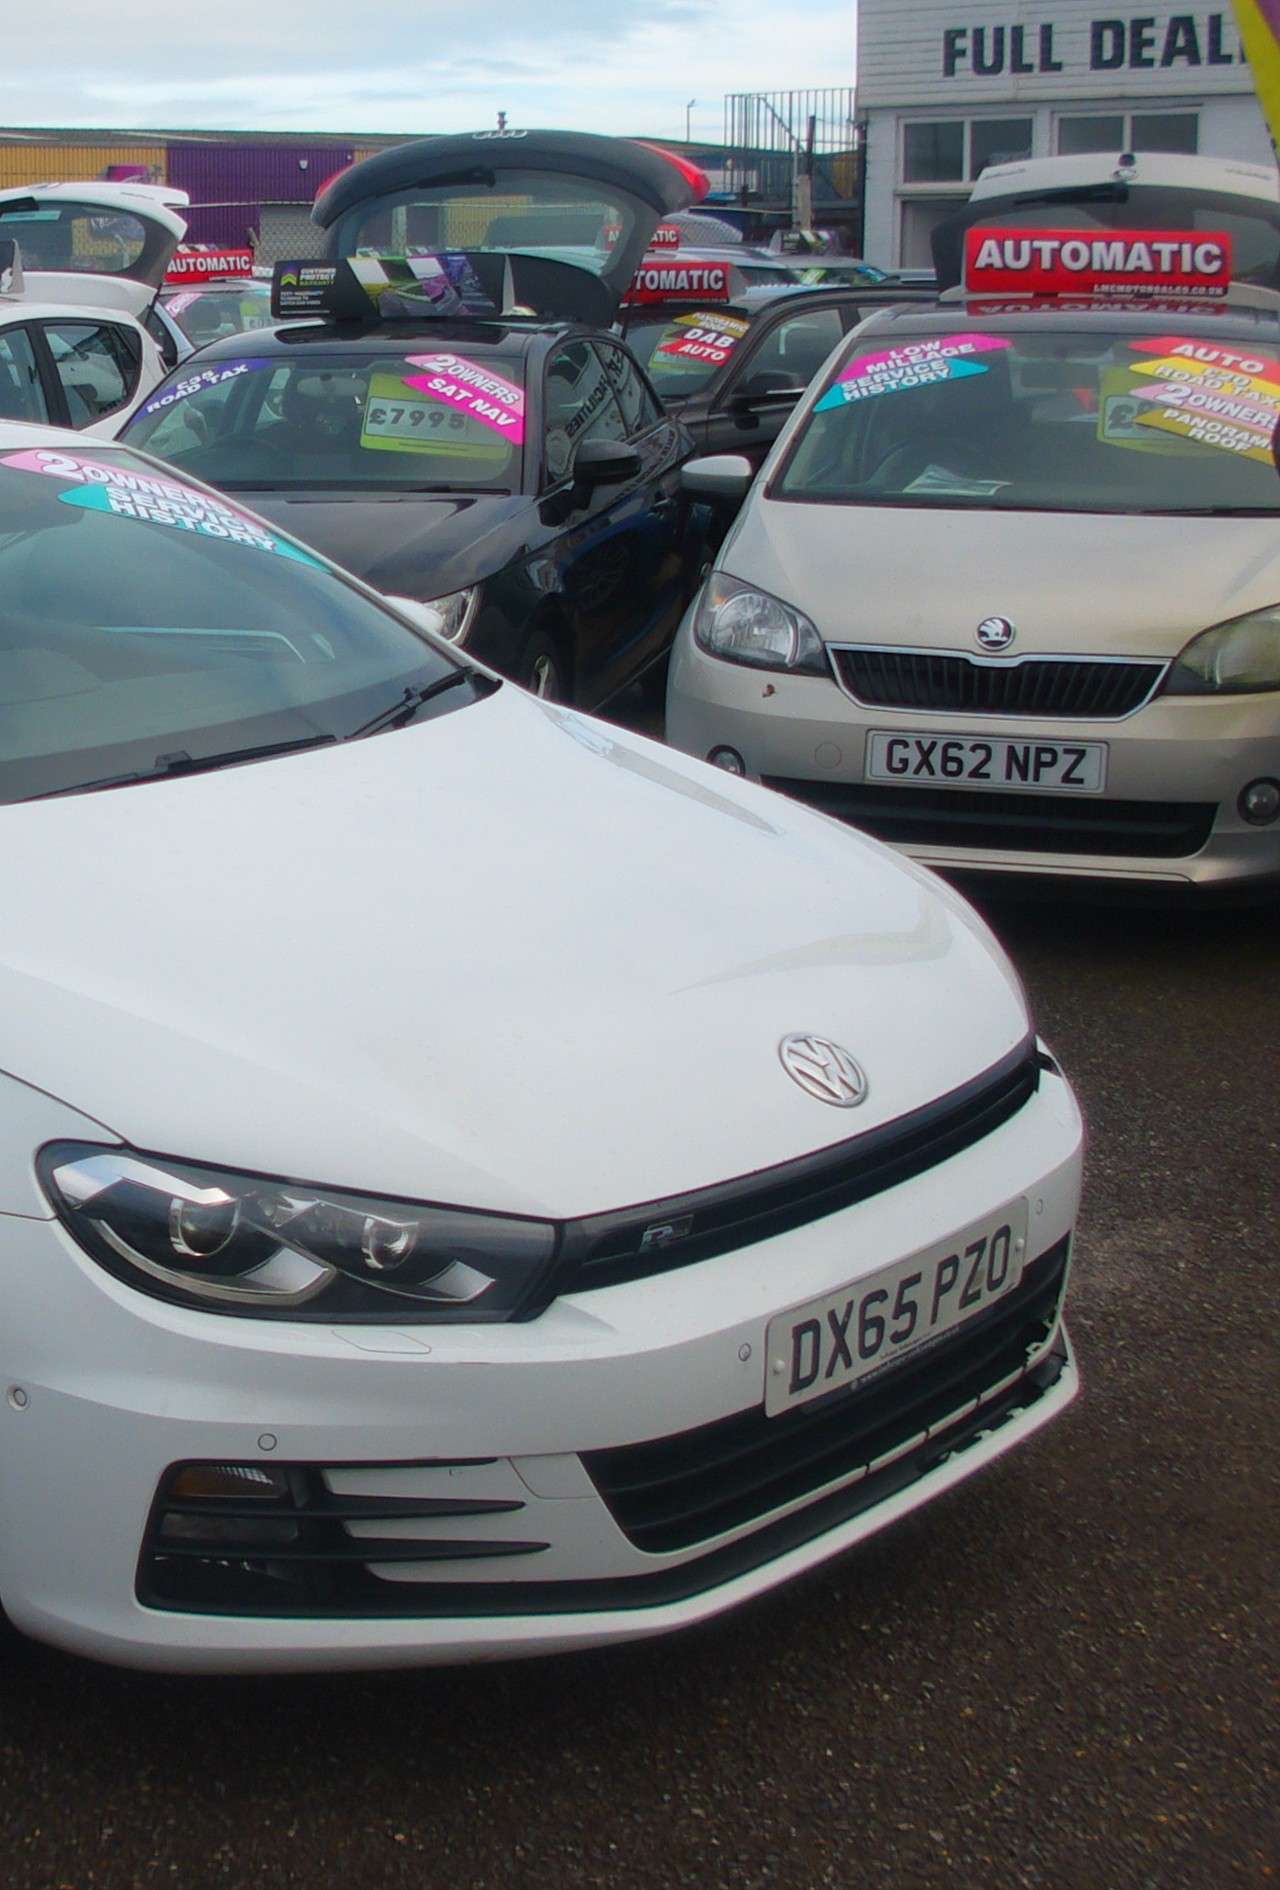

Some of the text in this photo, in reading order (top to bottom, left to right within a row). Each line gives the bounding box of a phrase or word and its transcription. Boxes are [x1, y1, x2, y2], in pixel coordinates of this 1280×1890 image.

[943, 13, 1247, 77] FULL DEAL
[167, 256, 249, 273] AUTOMATIC
[975, 239, 1222, 274] AUTOMATIC
[634, 269, 723, 290] TOMATIC
[678, 344, 727, 360] AUTO
[684, 328, 735, 348] DAB
[889, 341, 941, 358] LOW
[841, 359, 947, 390] SERVICE
[866, 344, 975, 374] MILEAGE
[1171, 344, 1264, 373] AUTO
[147, 364, 249, 413] ROAD TAX
[423, 353, 519, 405] 2 OWNERS
[843, 369, 951, 400] HISTORY
[1154, 382, 1193, 405] 2
[1155, 366, 1280, 409] ROAD TAX
[369, 407, 466, 430] £7995
[427, 378, 517, 426] SAT NAV
[1163, 408, 1272, 449] PANORAM
[1187, 428, 1253, 451] ROOF
[35, 451, 233, 517] 2 OWNERS
[106, 487, 268, 538] SERVICE
[108, 499, 276, 551] HISTORY
[886, 739, 1087, 785] GX62 NPZ
[789, 1272, 922, 1395] DX65
[929, 1225, 1011, 1326] PZO
